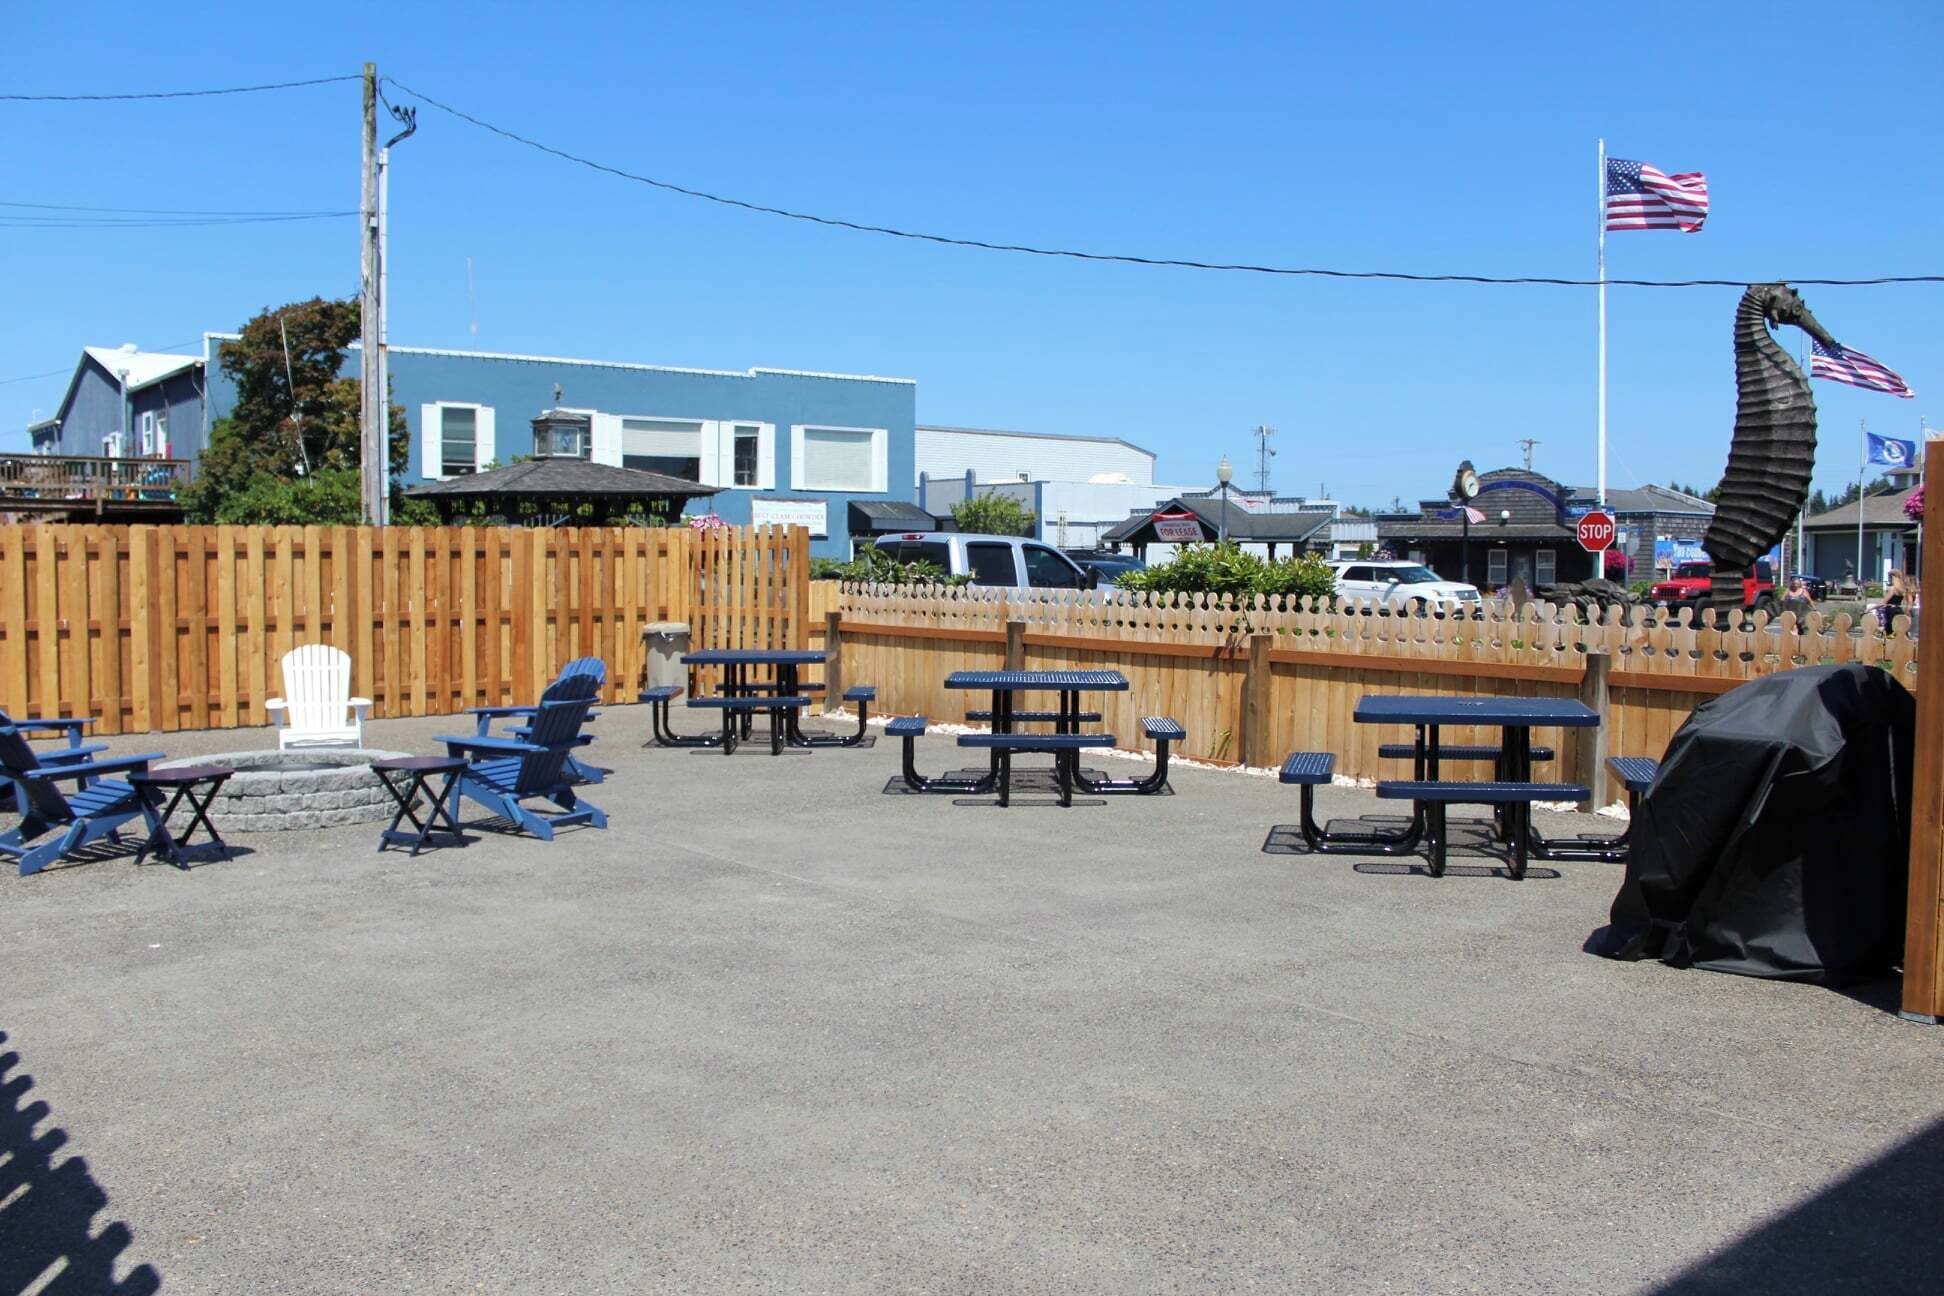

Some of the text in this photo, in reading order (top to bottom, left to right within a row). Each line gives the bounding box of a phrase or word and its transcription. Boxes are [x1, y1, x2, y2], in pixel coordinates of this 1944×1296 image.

[1160, 527, 1198, 537] FOR LEASE
[1580, 524, 1611, 539] STOP
